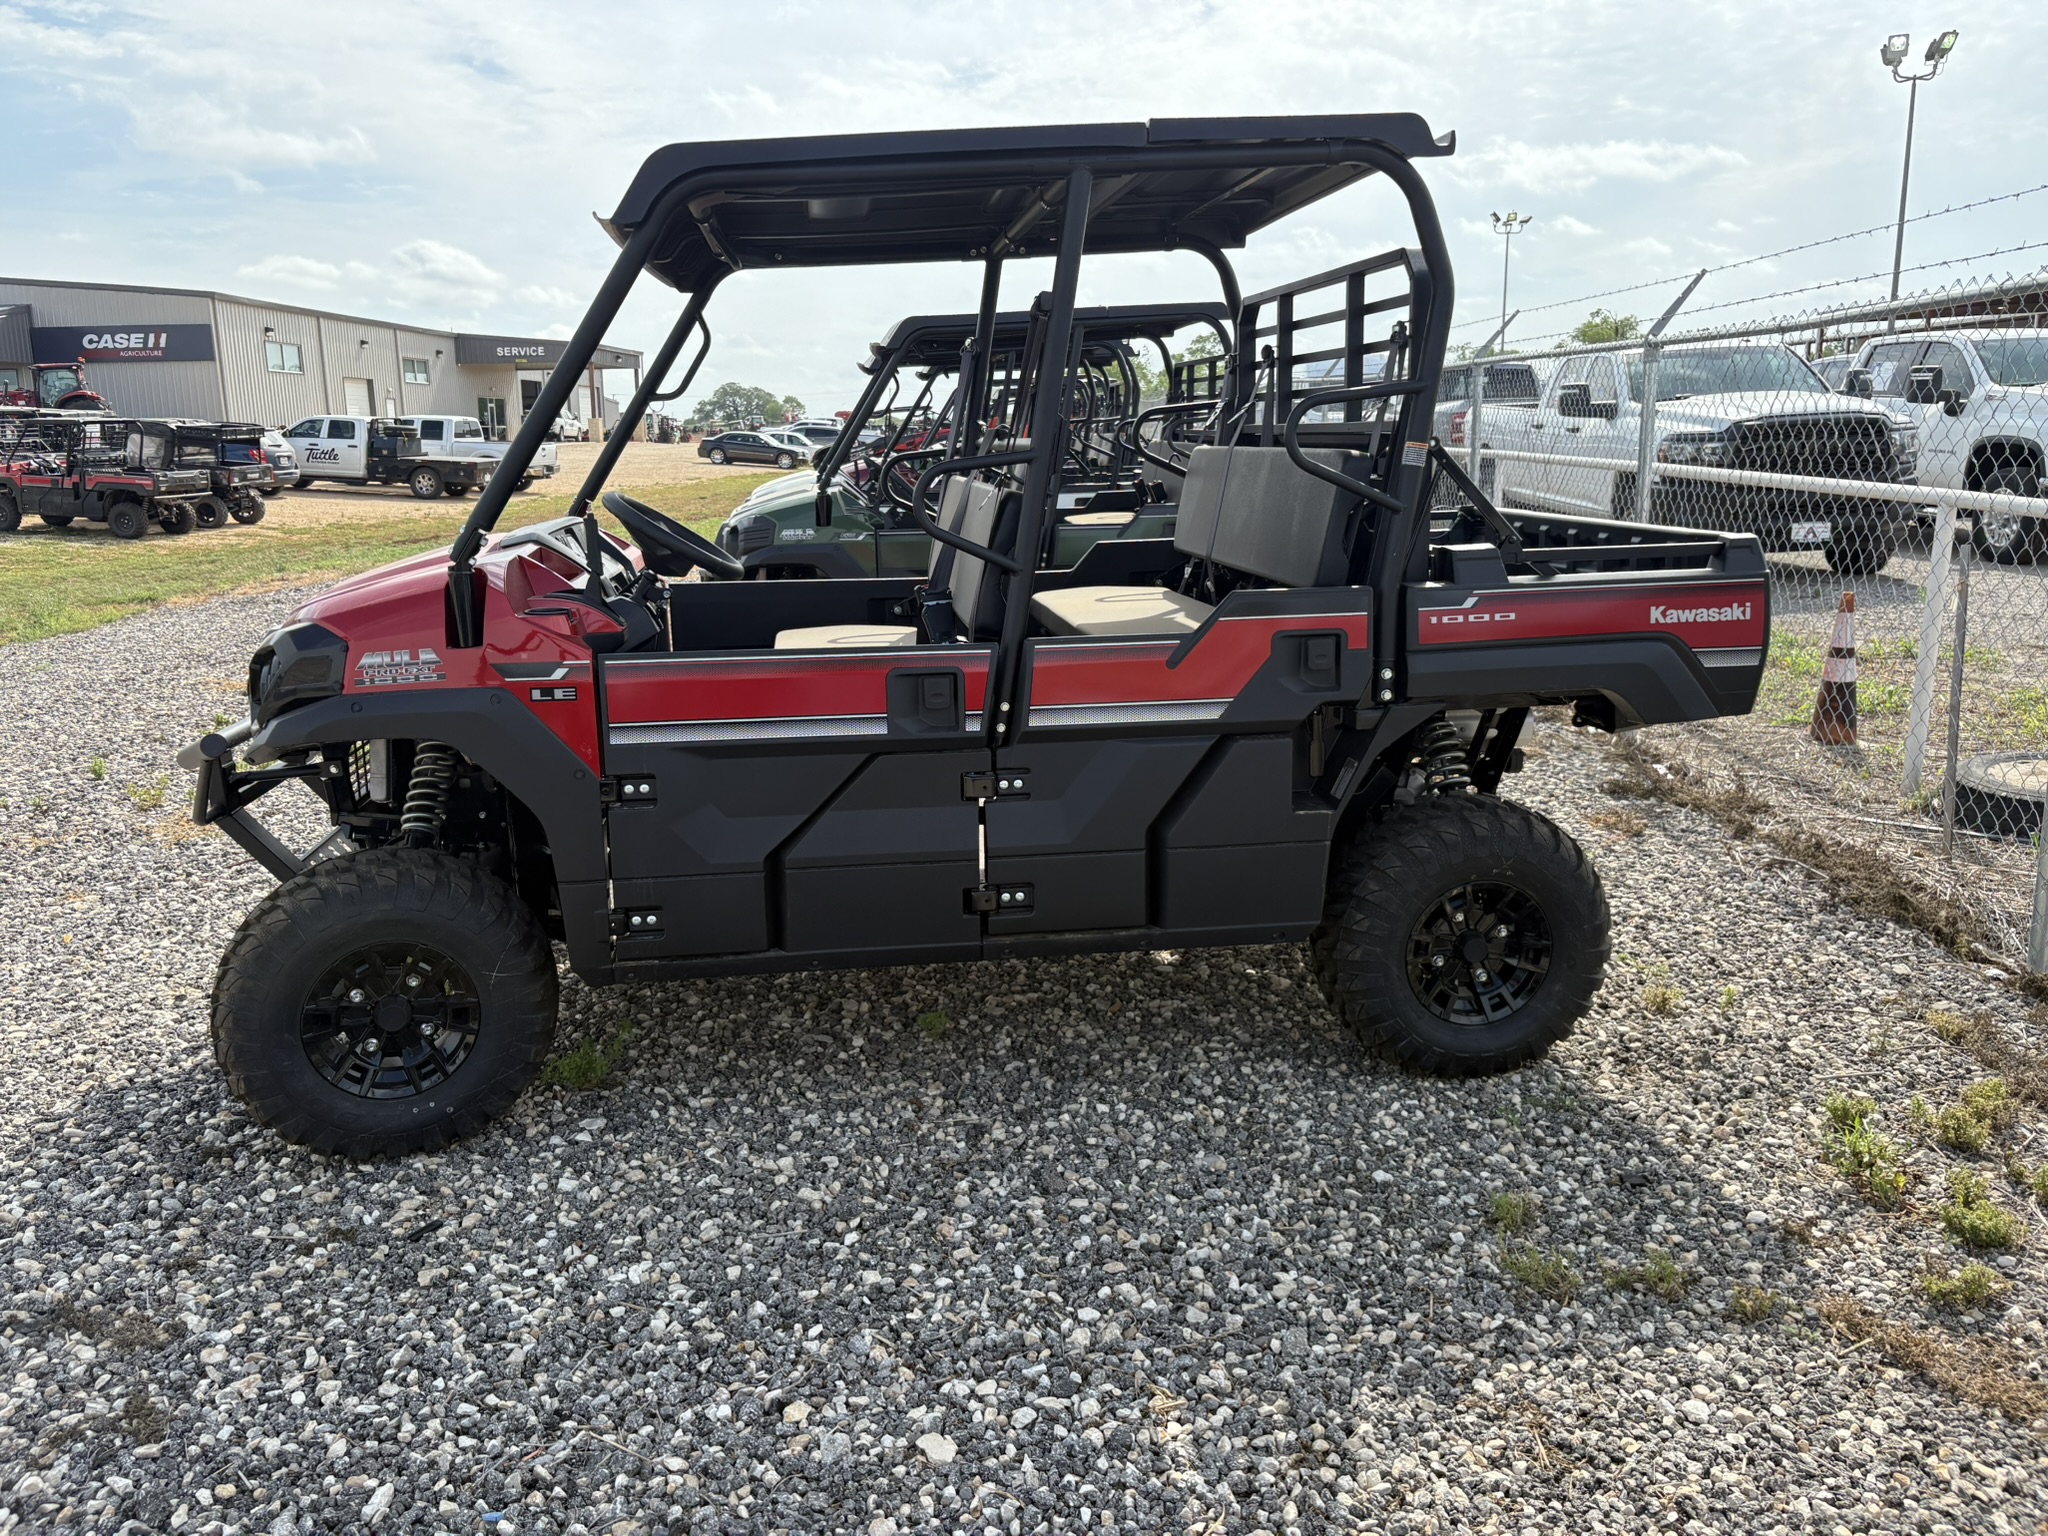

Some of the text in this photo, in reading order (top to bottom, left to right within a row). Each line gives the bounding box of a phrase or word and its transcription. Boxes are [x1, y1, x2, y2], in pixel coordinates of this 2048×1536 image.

[82, 333, 145, 349] CASE
[119, 349, 163, 357] AGRICULTURE
[496, 346, 546, 356] SERVICE
[305, 447, 340, 463] Tuttle
[1429, 612, 1516, 624] 1000
[1649, 602, 1752, 625] Kawasaki
[354, 648, 444, 671] MULE
[531, 688, 577, 700] LE
